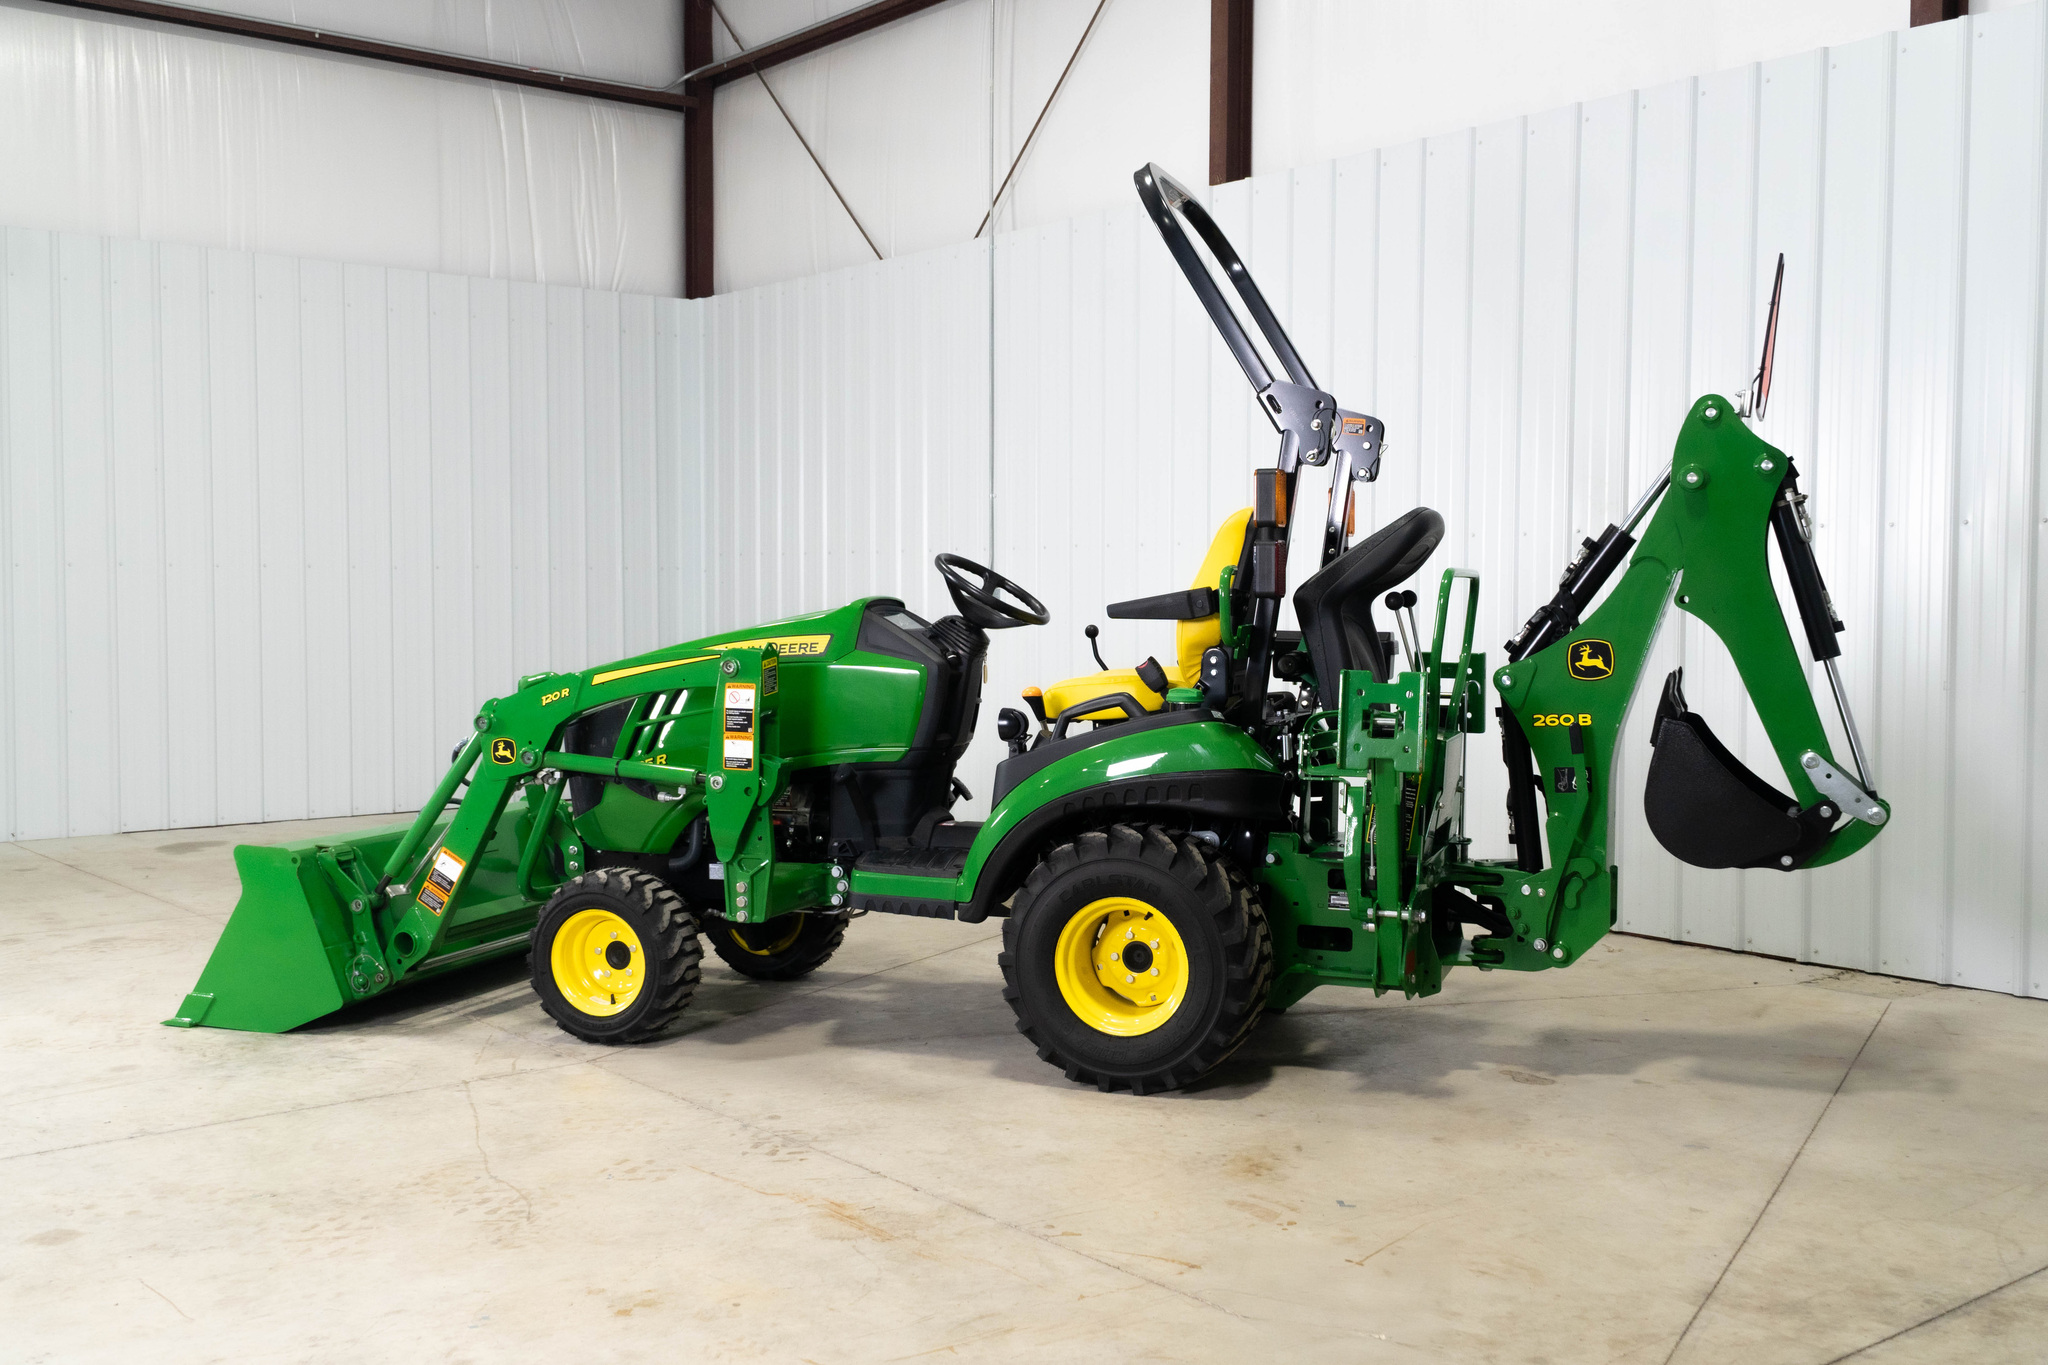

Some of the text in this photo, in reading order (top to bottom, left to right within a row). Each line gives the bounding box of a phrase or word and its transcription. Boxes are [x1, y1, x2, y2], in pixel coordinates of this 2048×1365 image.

[541, 691, 560, 706] 120
[1533, 714, 1592, 727] 260 B
